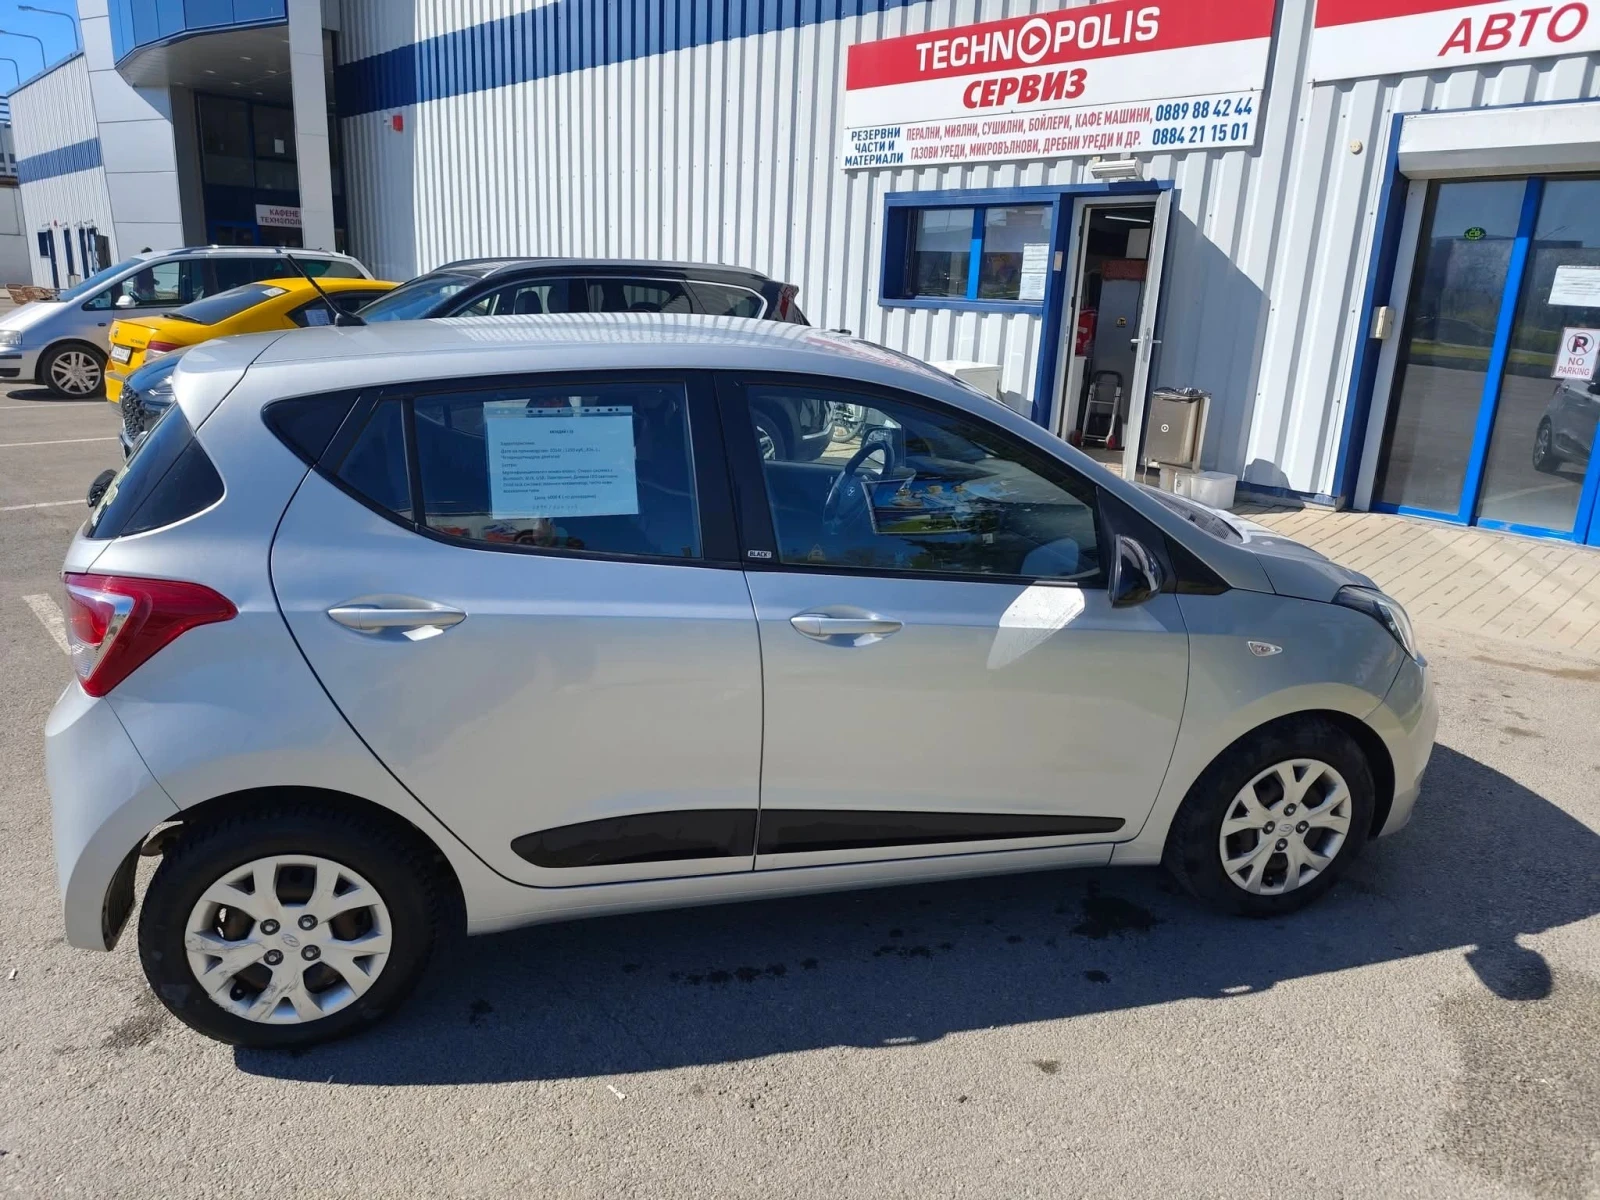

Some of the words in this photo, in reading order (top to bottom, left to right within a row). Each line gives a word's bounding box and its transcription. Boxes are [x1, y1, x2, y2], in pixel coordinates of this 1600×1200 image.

[916, 6, 1161, 72] TECHNOPOLIS
[1437, 2, 1589, 57] АВТО
[963, 68, 1088, 109] СЕРВИЗ
[1155, 102, 1189, 122] 0889
[1192, 100, 1210, 119] 88
[1213, 98, 1231, 117] 42
[1234, 97, 1252, 115] 44
[851, 126, 901, 142] РЕЗЕРВНИ
[906, 126, 943, 141] ПЕРАЛНИ,
[944, 122, 980, 138] МИЯЛНИ,
[982, 119, 1026, 136] СУШИЛНИ,
[1028, 114, 1073, 132] БОЙЛЕРИ,
[1075, 111, 1103, 128] КАФЕ
[1104, 107, 1153, 125] МАШИНИ,
[1152, 127, 1185, 145] 0884
[1189, 125, 1206, 143] 21
[1211, 123, 1228, 142] 15
[1230, 122, 1248, 141] 01
[855, 142, 886, 154] ЧАСТИ
[888, 140, 895, 151] И
[911, 146, 938, 160] ГАЗОВИ
[940, 143, 967, 160] УРЕДИ,
[969, 138, 1041, 157] МИКРОВЪЛНОВИ,
[1043, 135, 1080, 154] ДРЕБНИ
[1082, 132, 1115, 150] УРЕДИ
[1116, 131, 1123, 147] И
[1124, 130, 1141, 148] ДР.
[845, 152, 904, 167] МАТЕРИАЛИ
[269, 209, 299, 217] КАФЕНЕ
[1558, 366, 1590, 376] PARKING
[1567, 357, 1585, 366] NO
